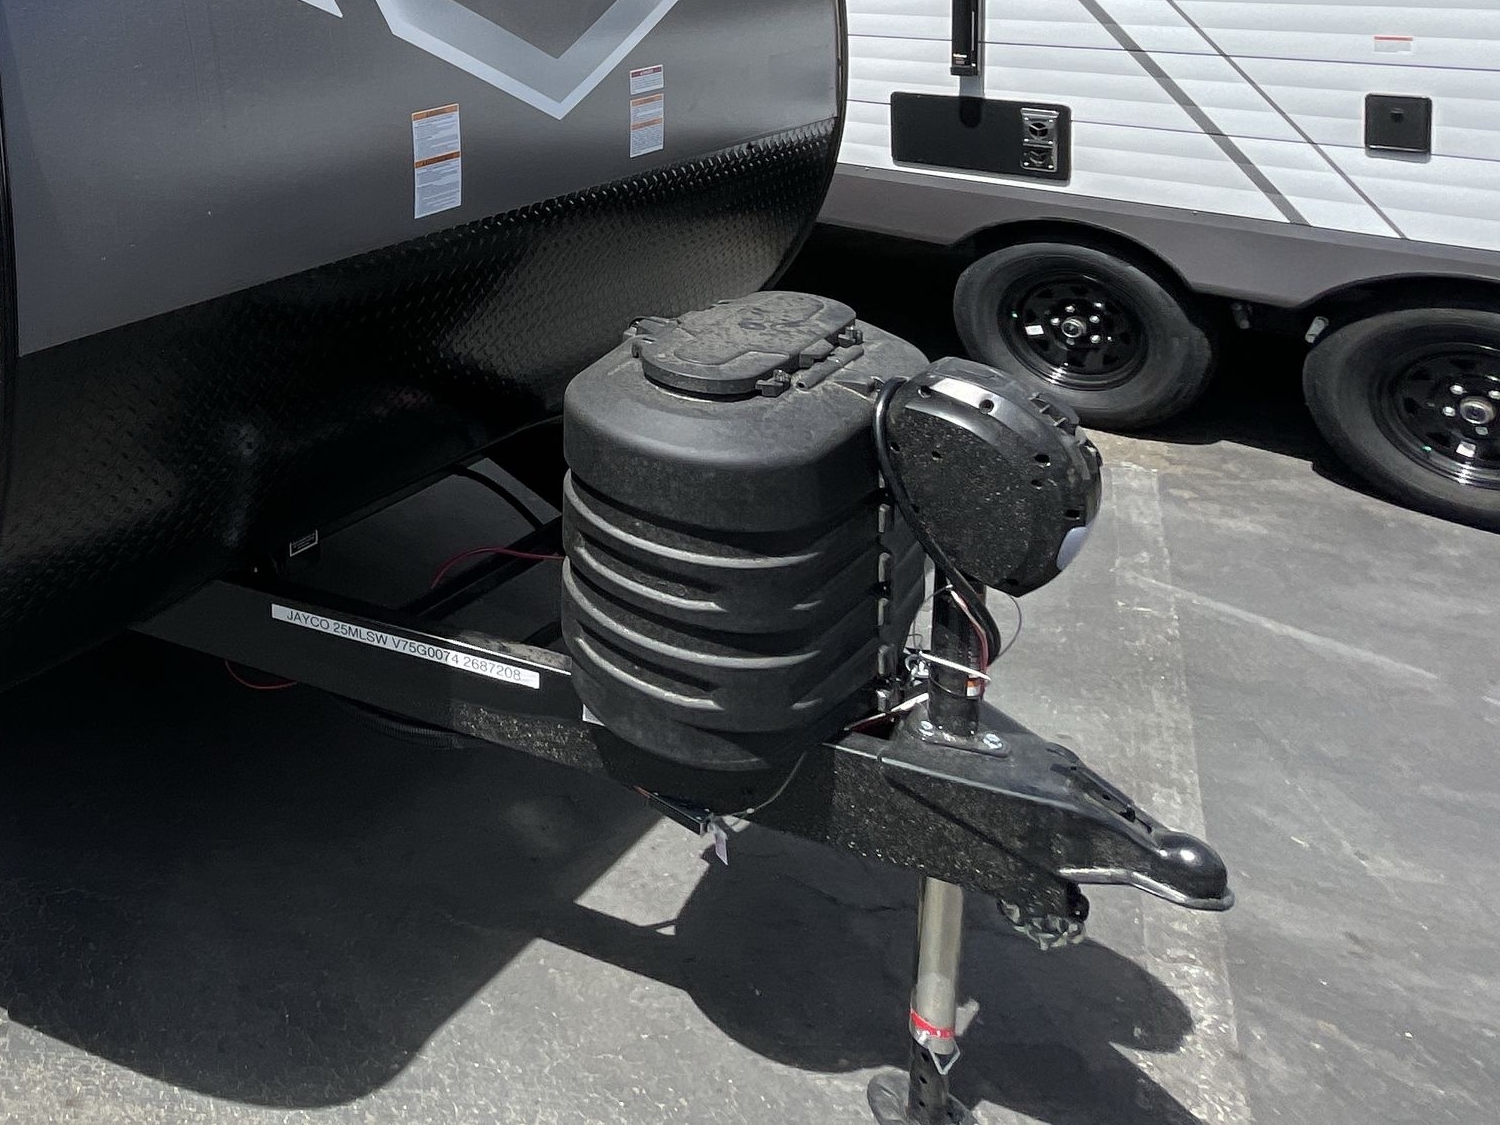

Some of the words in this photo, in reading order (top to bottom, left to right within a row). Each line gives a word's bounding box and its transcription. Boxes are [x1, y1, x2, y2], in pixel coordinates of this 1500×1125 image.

[286, 609, 330, 630] JAYCO
[333, 623, 388, 646] 25MLSW
[391, 637, 459, 665] V75G0074
[463, 656, 521, 682] 2687208
